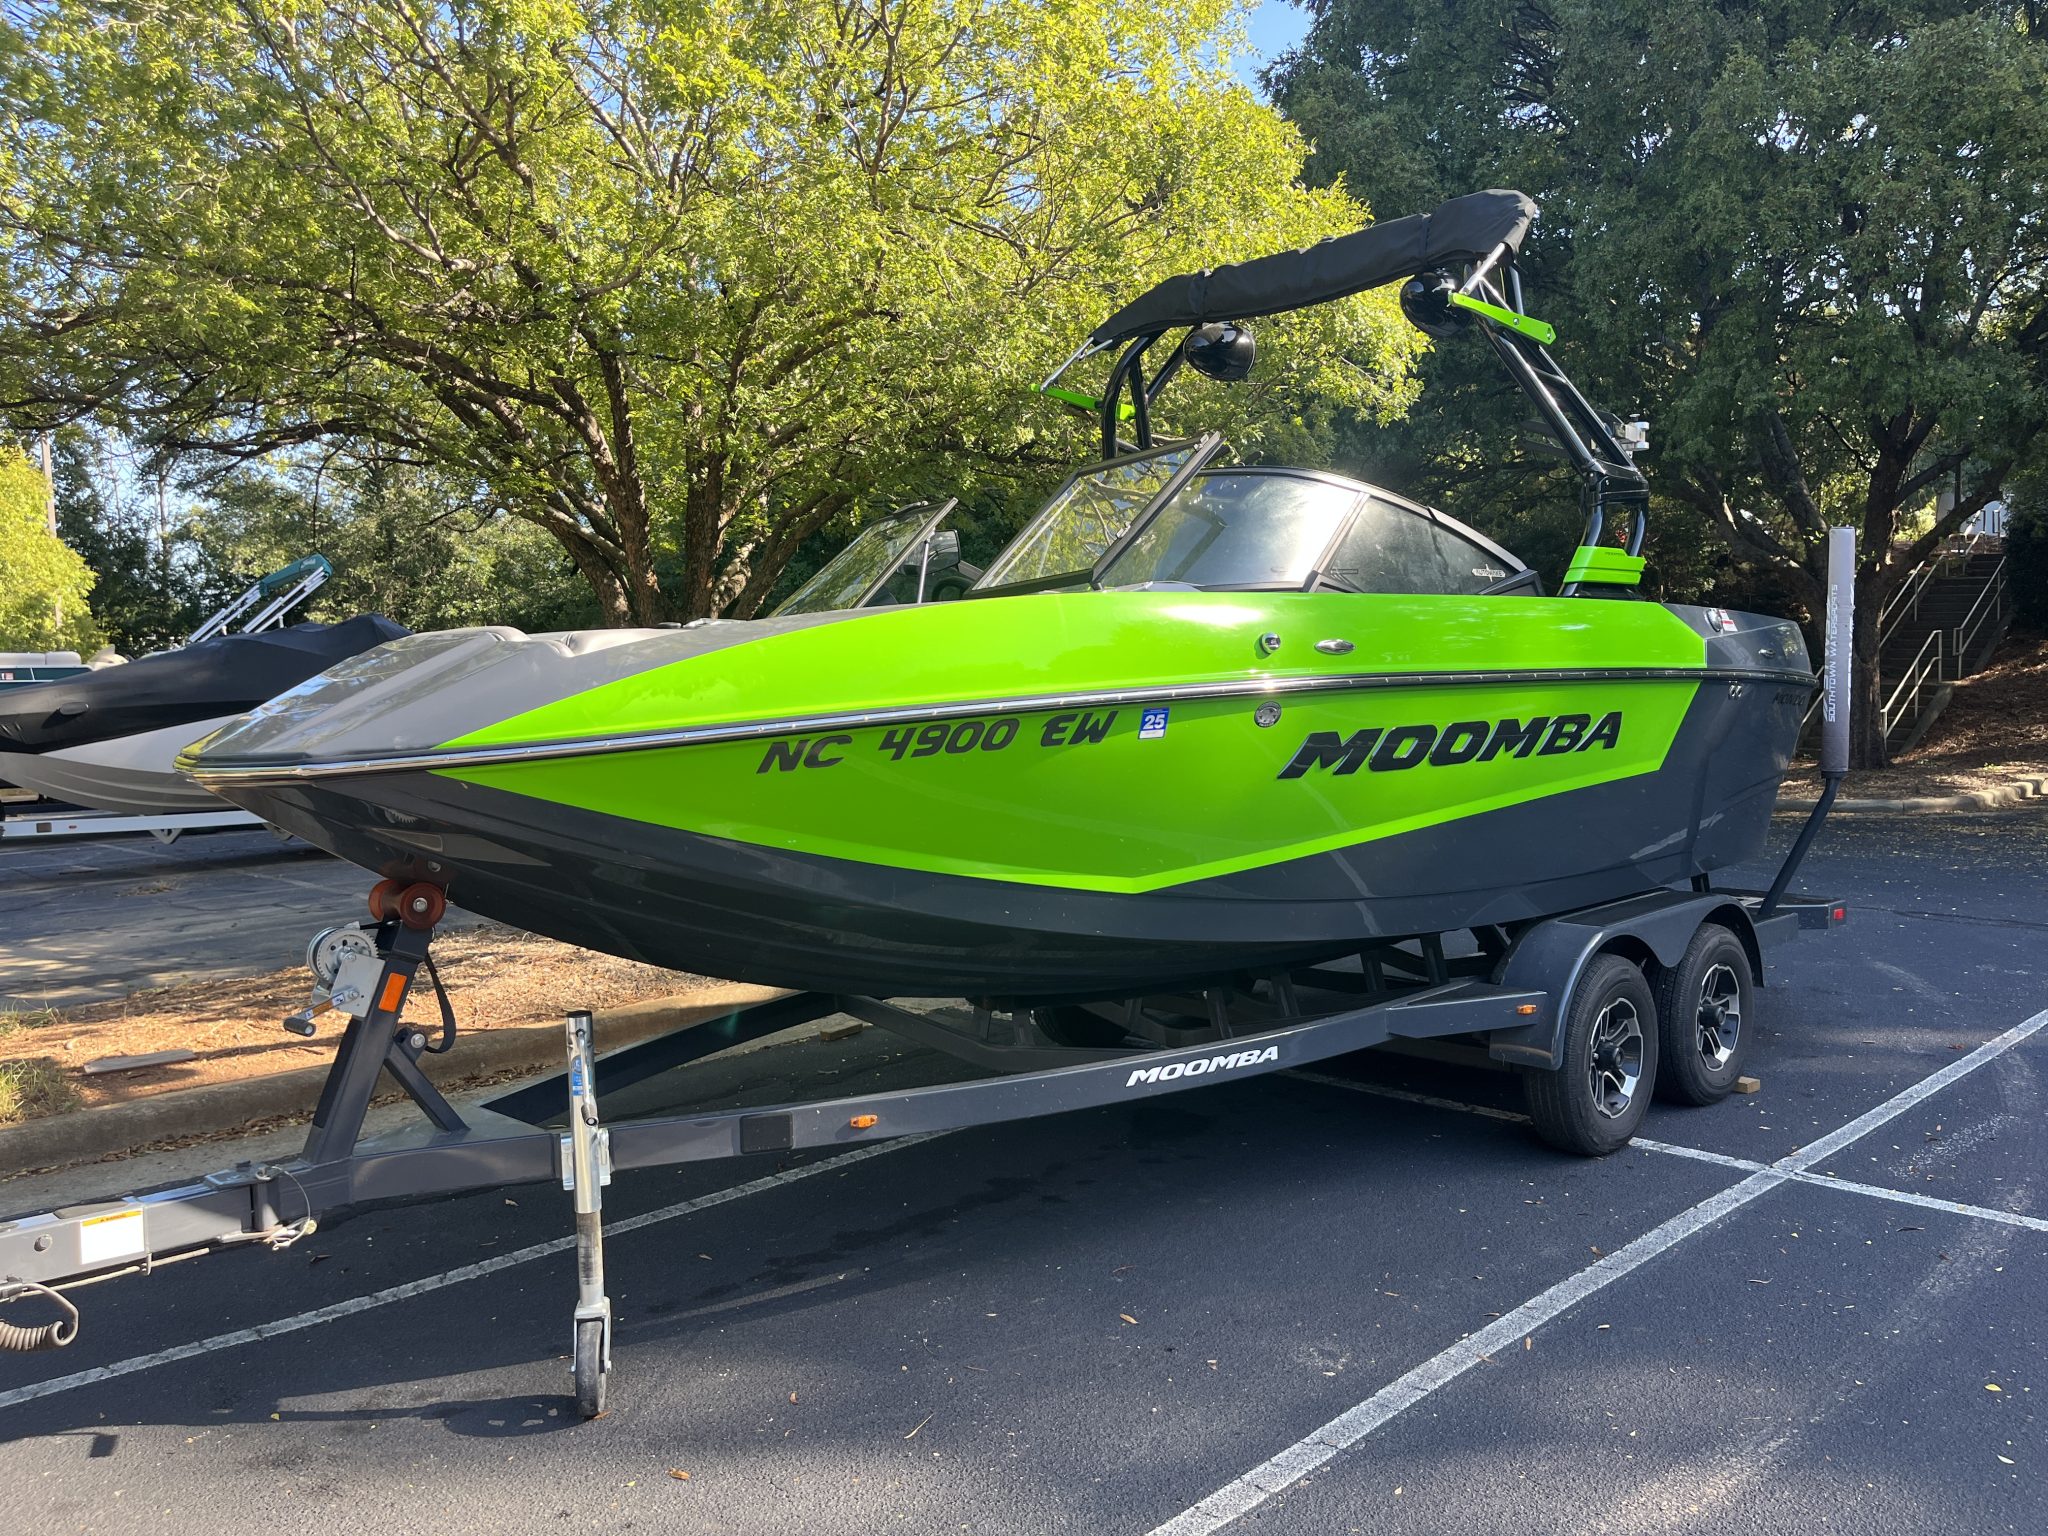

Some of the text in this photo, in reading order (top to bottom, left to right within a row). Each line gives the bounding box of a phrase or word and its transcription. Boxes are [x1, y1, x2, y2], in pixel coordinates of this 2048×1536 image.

[1828, 584, 1838, 722] SOUTHTOWN WATERSPORTS
[756, 710, 1119, 774] NC 4900 EW
[1143, 714, 1165, 730] 25
[1278, 711, 1622, 779] MOOMBA
[1126, 1046, 1279, 1087] MOOMBA
